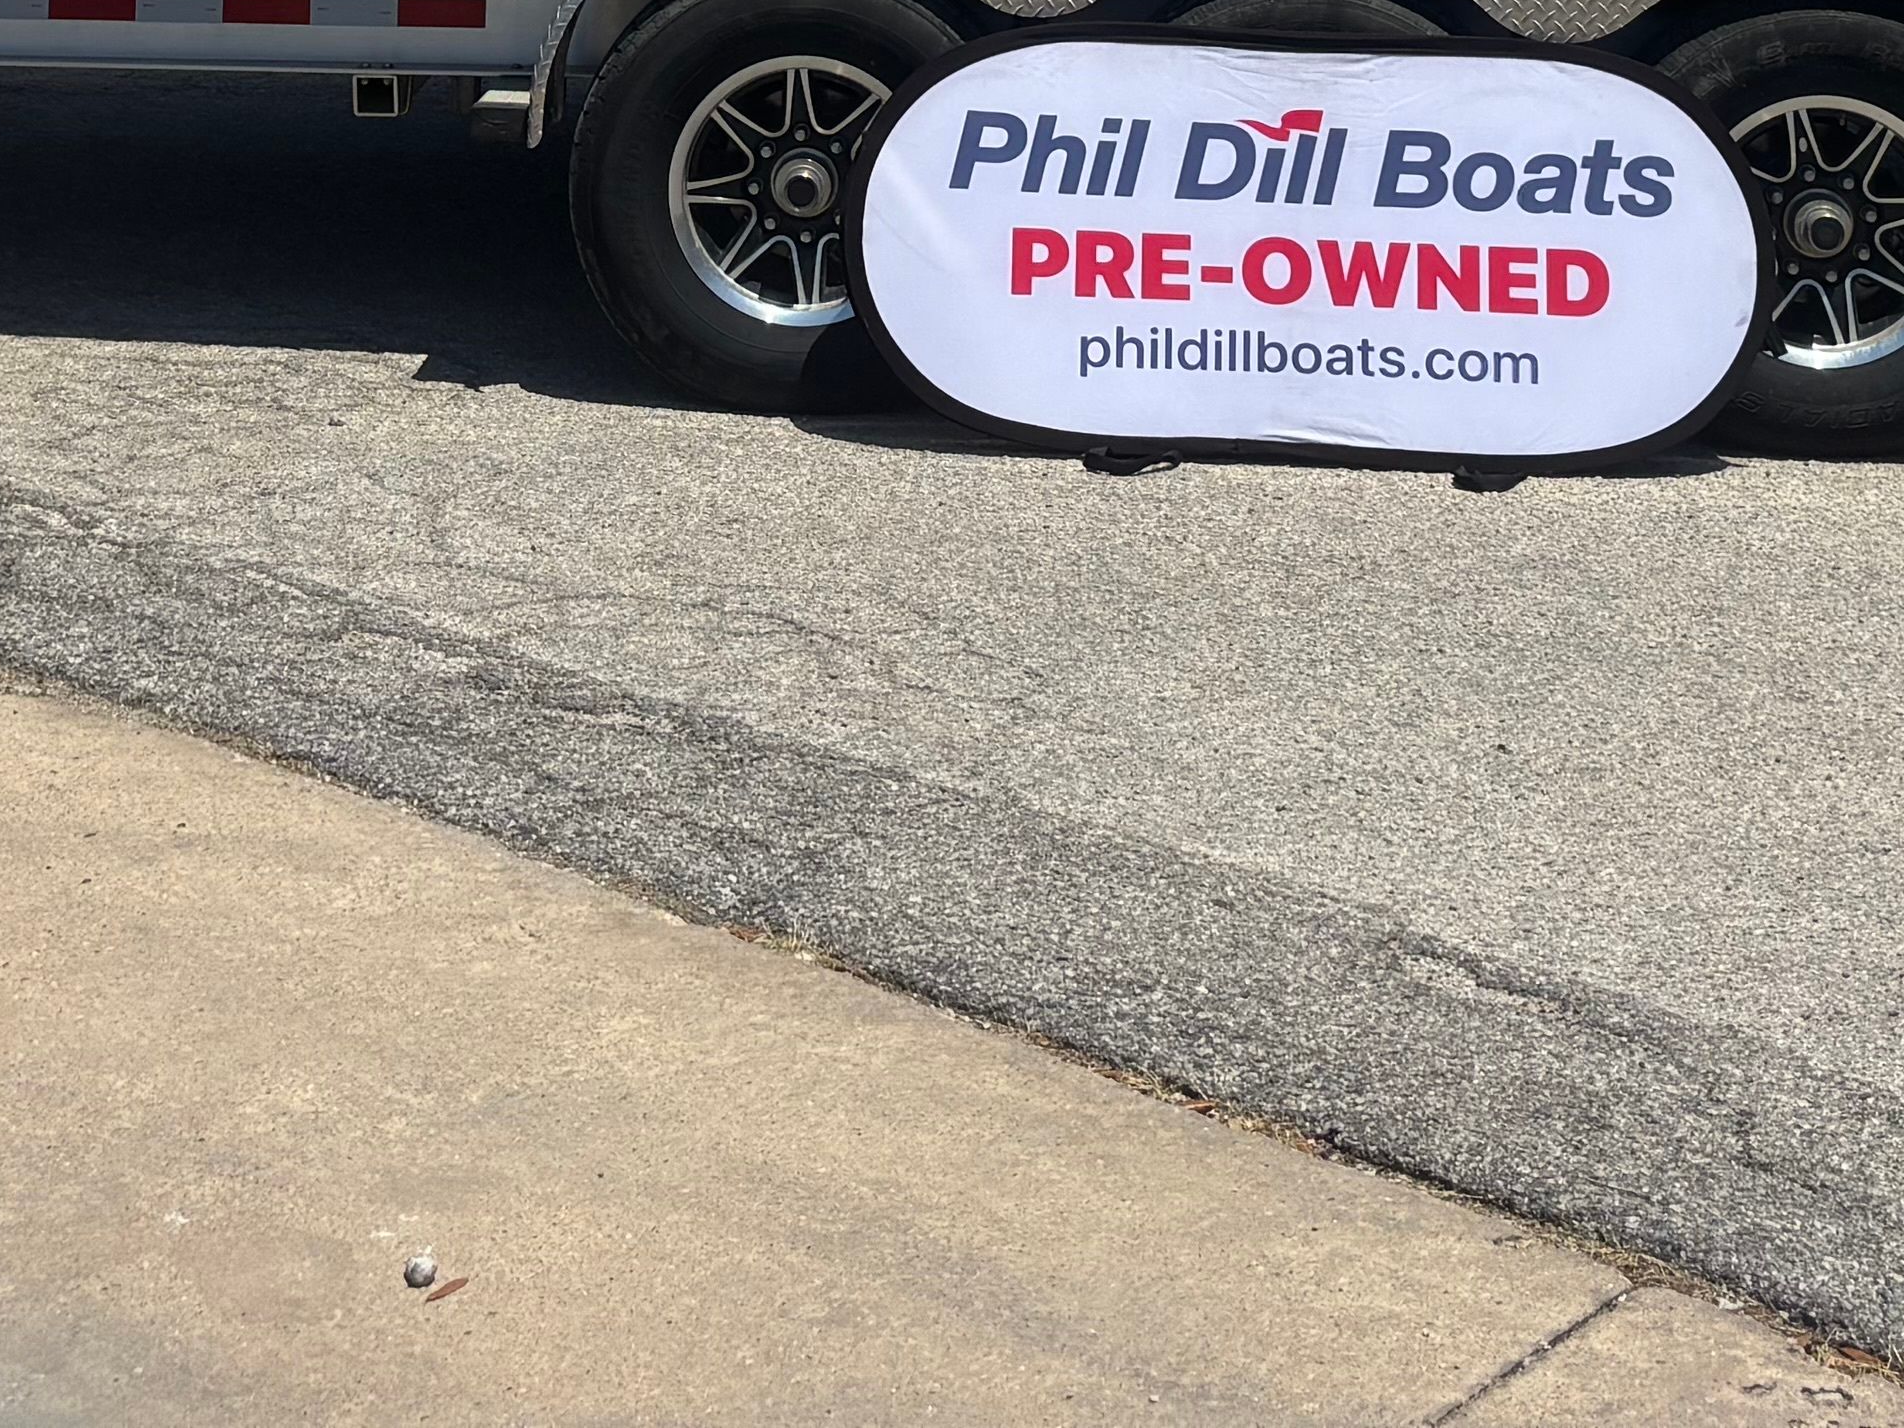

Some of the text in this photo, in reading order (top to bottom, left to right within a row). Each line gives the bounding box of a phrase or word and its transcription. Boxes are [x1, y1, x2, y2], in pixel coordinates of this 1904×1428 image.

[948, 109, 1675, 219] Phil Dill Boats
[1009, 227, 1611, 317] PRE-OWNED
[1079, 326, 1541, 386] phildillboats.com
